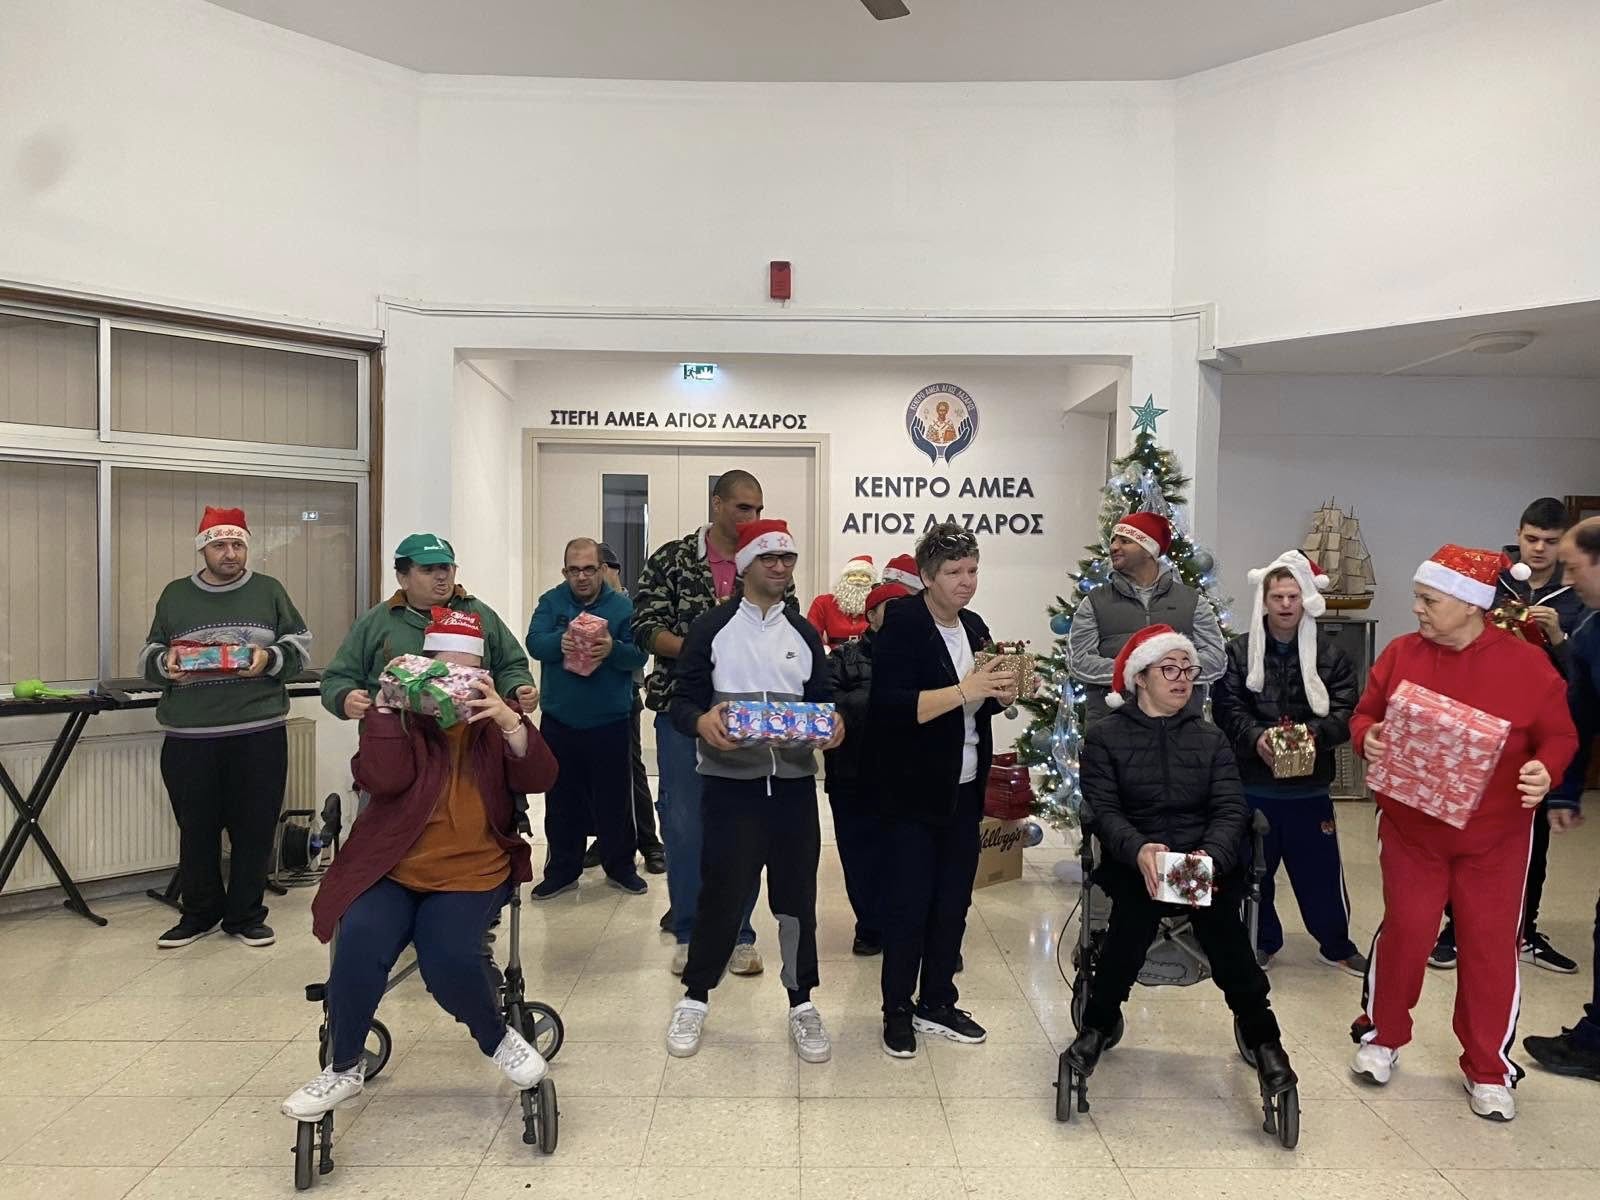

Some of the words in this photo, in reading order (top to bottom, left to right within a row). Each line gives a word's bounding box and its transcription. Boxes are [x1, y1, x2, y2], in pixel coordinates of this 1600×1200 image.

[550, 409, 599, 426] ΣΤΕΓΗ
[604, 411, 659, 427] ΑΜΕΑ
[664, 412, 717, 428] ΑΓΙΟΣ
[722, 413, 807, 430] ΛΑΖΑΡΟΣ
[855, 476, 951, 498] ΚΕΝΤΡΟ
[958, 477, 1035, 498] ΑΜΕΑ
[842, 512, 915, 534] ΑΓΙΟΣ
